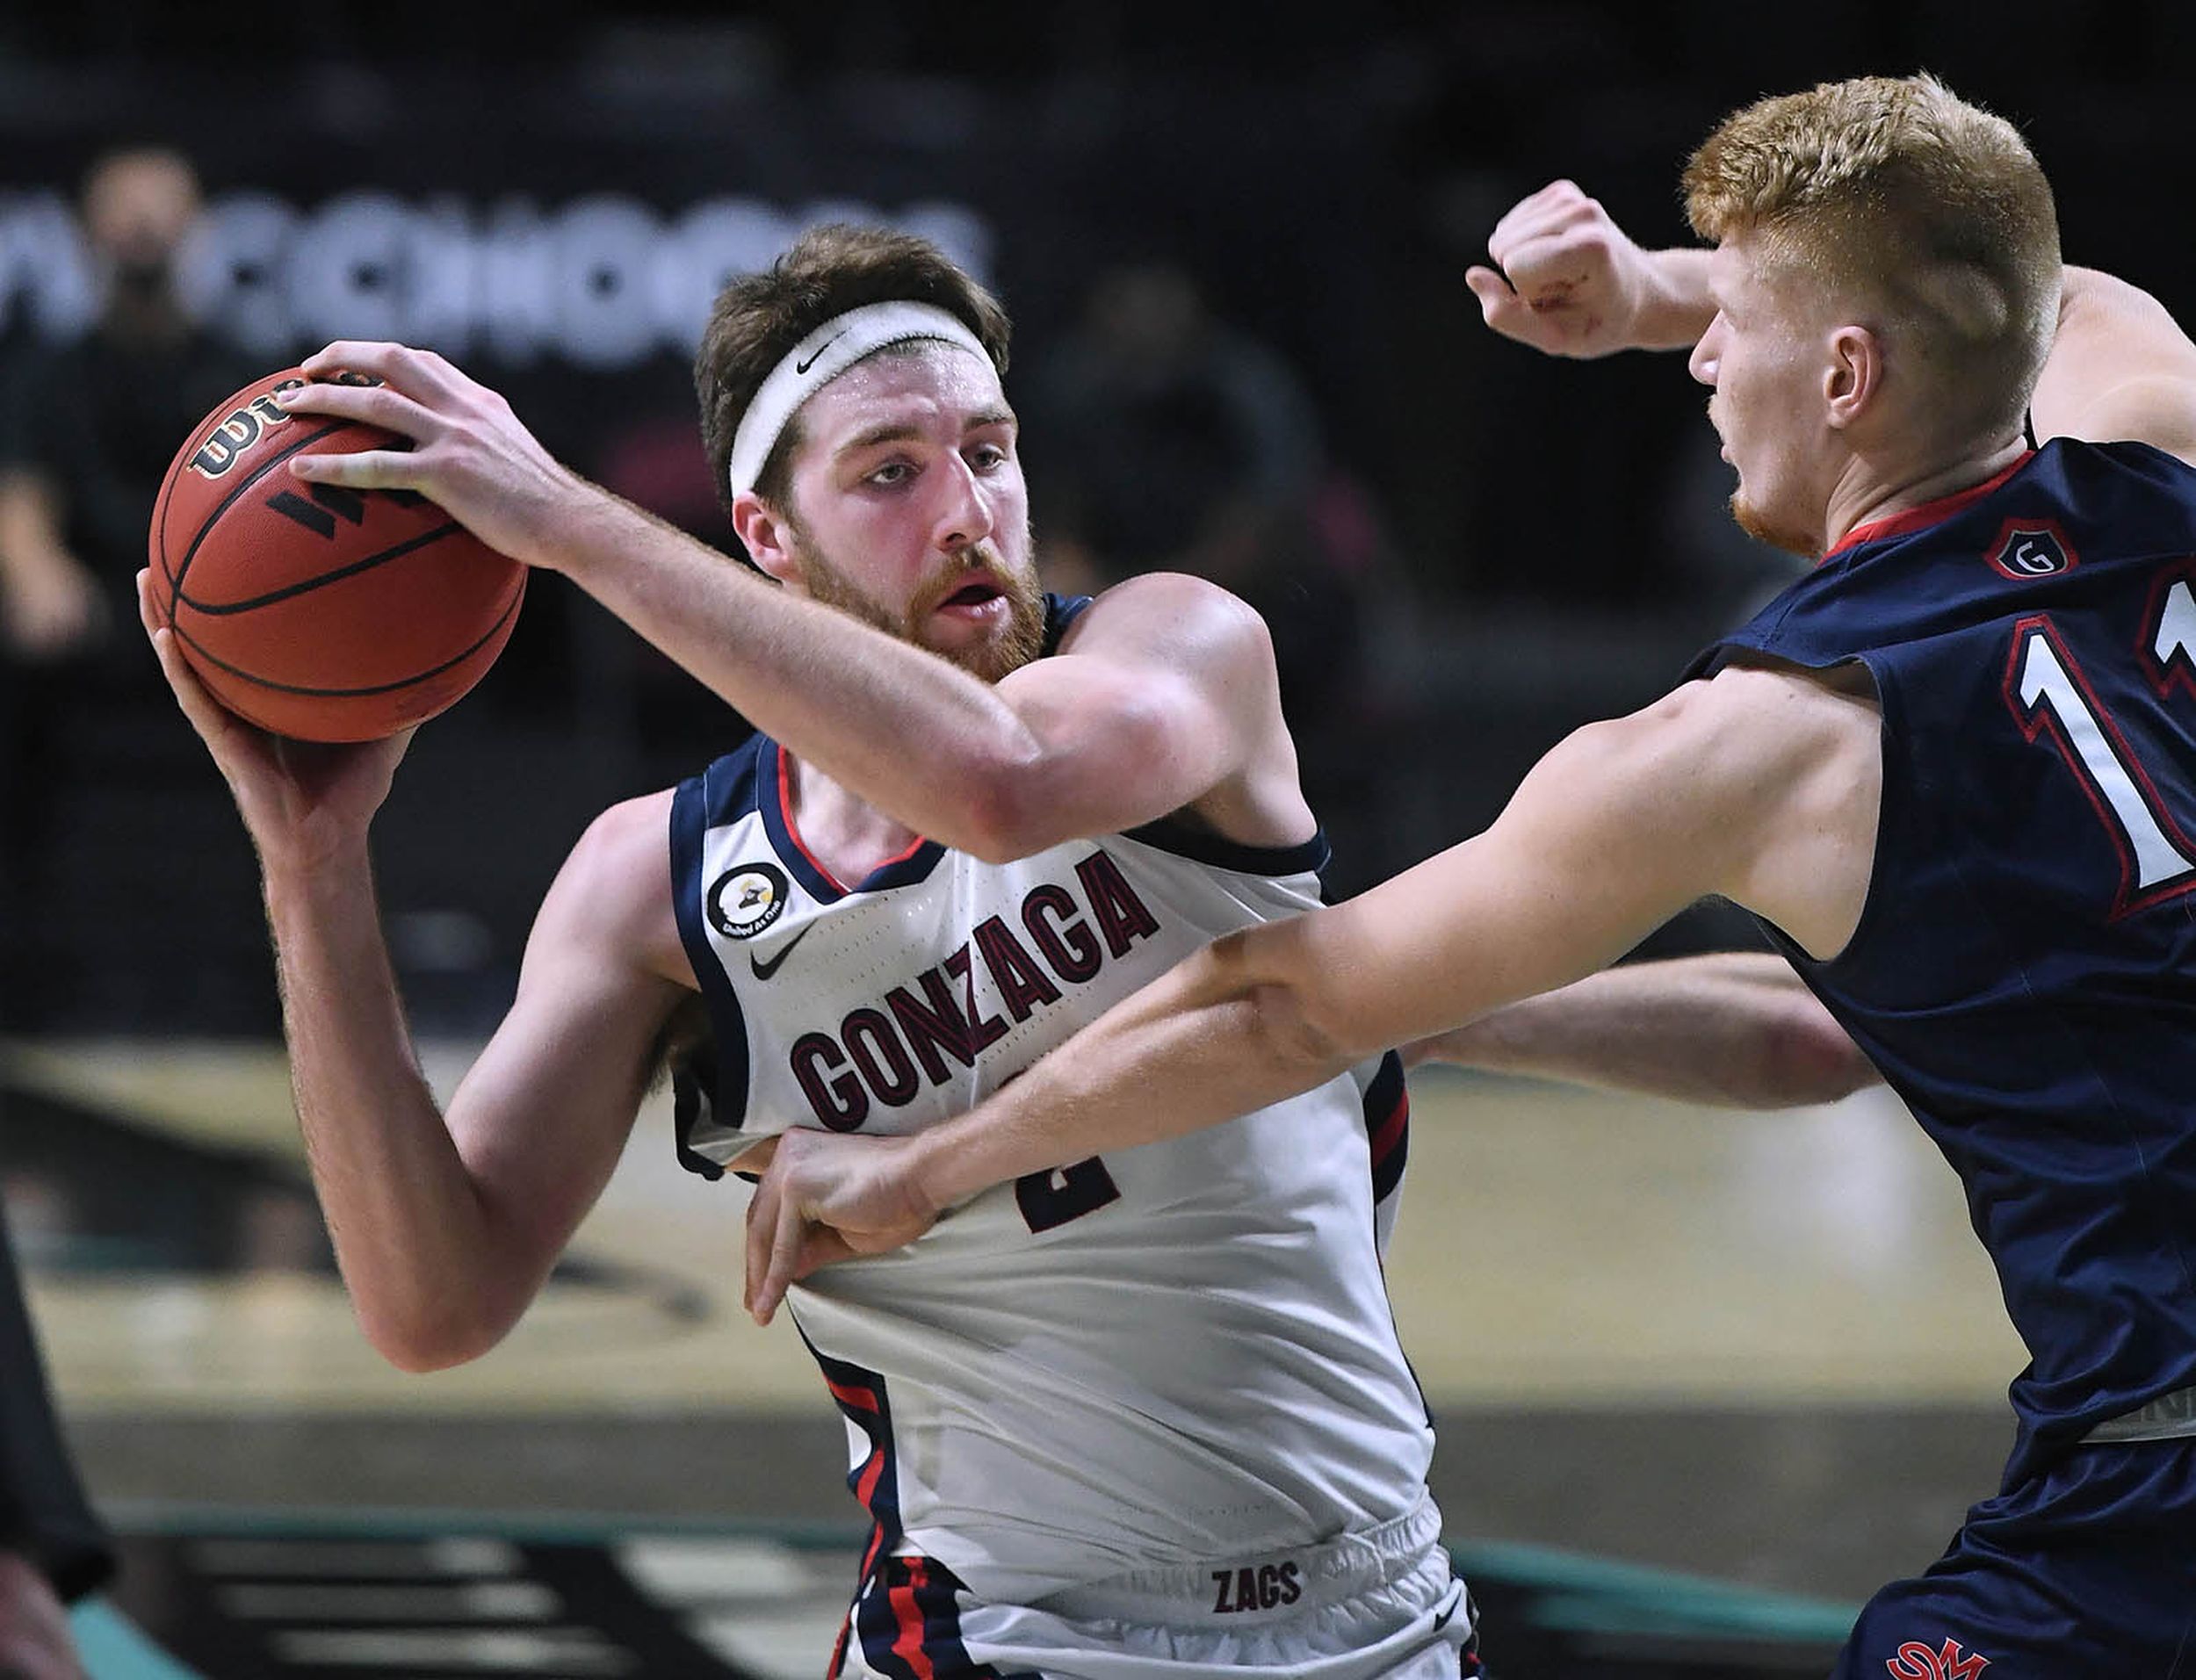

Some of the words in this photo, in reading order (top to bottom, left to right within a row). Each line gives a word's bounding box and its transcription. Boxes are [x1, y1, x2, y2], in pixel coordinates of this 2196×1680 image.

[2016, 541, 2055, 573] G
[790, 849, 1161, 1132] GONZAGA
[1212, 1561, 1302, 1613] ZAGS
